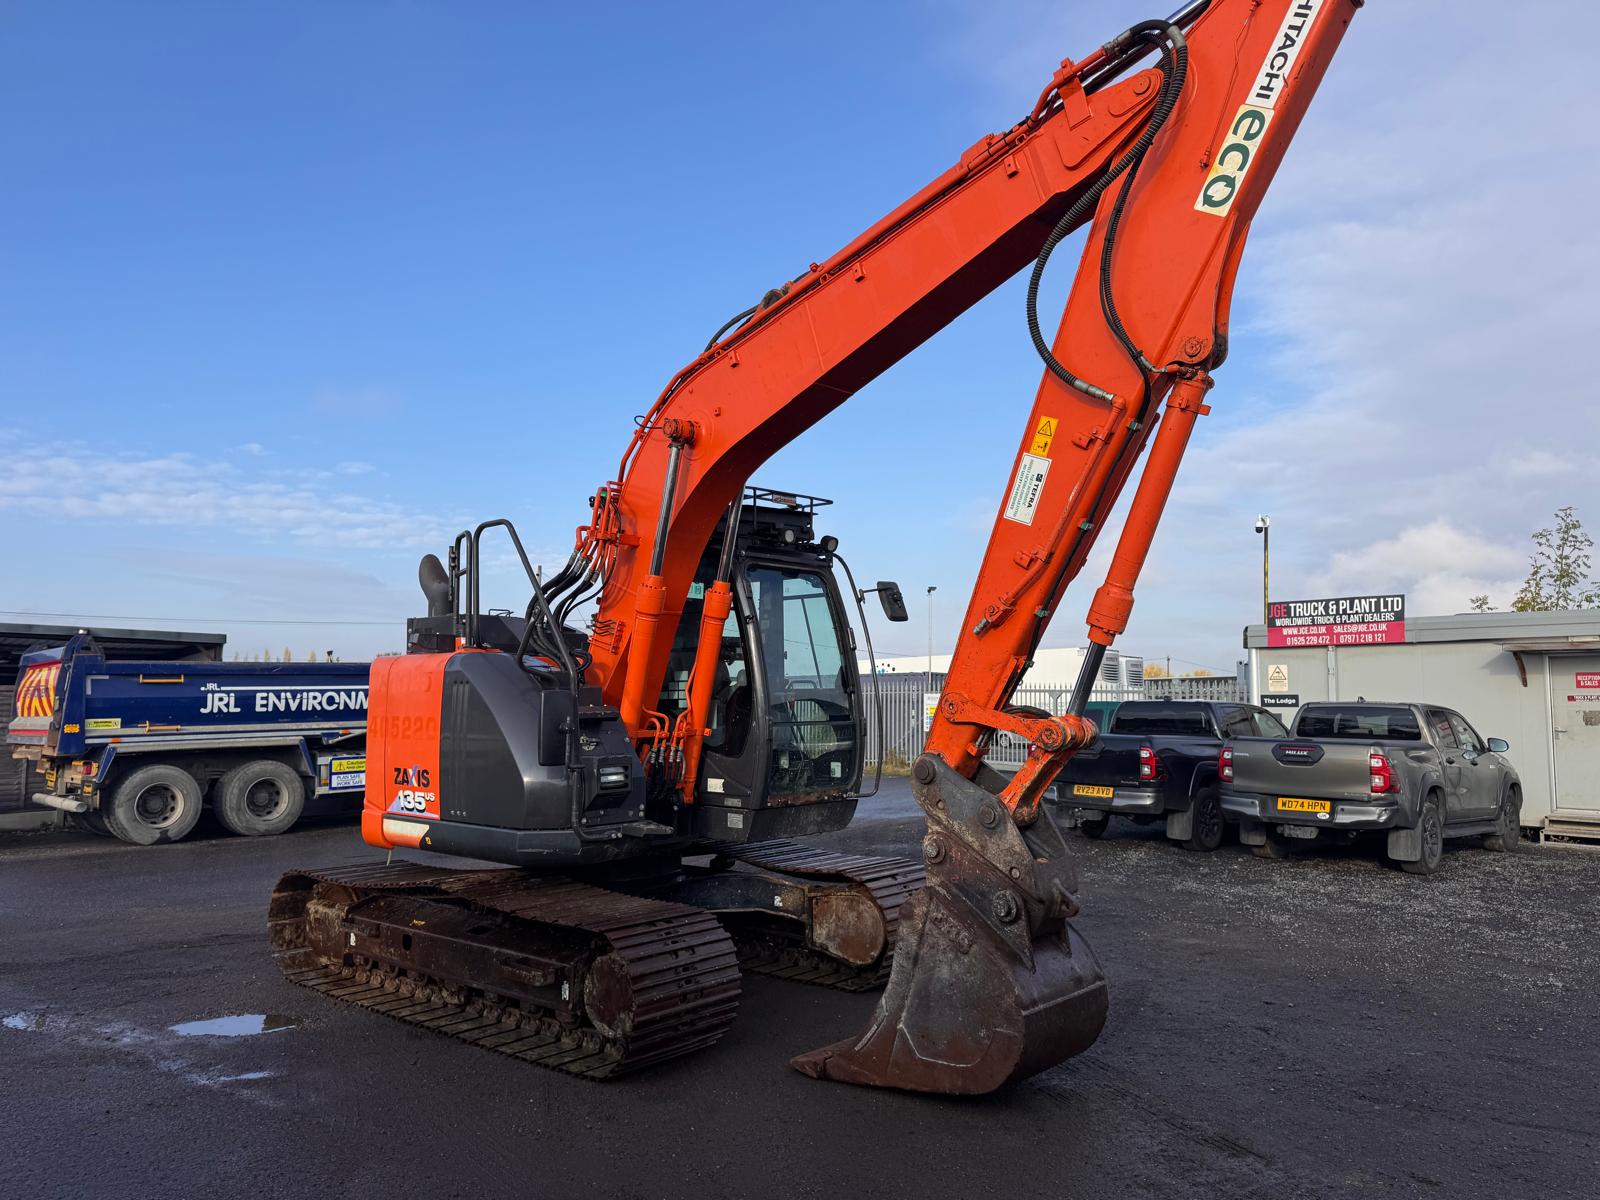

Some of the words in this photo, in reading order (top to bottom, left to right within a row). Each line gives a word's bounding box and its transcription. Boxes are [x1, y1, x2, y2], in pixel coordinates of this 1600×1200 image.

[1255, 0, 1313, 99] HITACHI
[1027, 483, 1039, 508] TEFRA
[1269, 603, 1287, 618] JGE
[1289, 602, 1326, 617] TRUCK
[1329, 601, 1337, 615] &
[1340, 599, 1377, 614] PLANT
[1380, 597, 1402, 612] LTD
[1275, 618, 1312, 627] WORLDWIDE
[1313, 617, 1335, 625] TRUCK
[1341, 615, 1363, 623] PLANT
[1364, 612, 1395, 622] DEALERS
[1333, 623, 1388, 633] SALES@JGE.CO.UK
[1340, 634, 1360, 643] 07971
[1375, 633, 1386, 642] 121
[200, 693, 241, 713] JRL
[394, 765, 430, 788] ZAXIS
[1076, 785, 1094, 795] RV23
[1281, 799, 1305, 809] WD74
[1307, 801, 1326, 811] HPN
